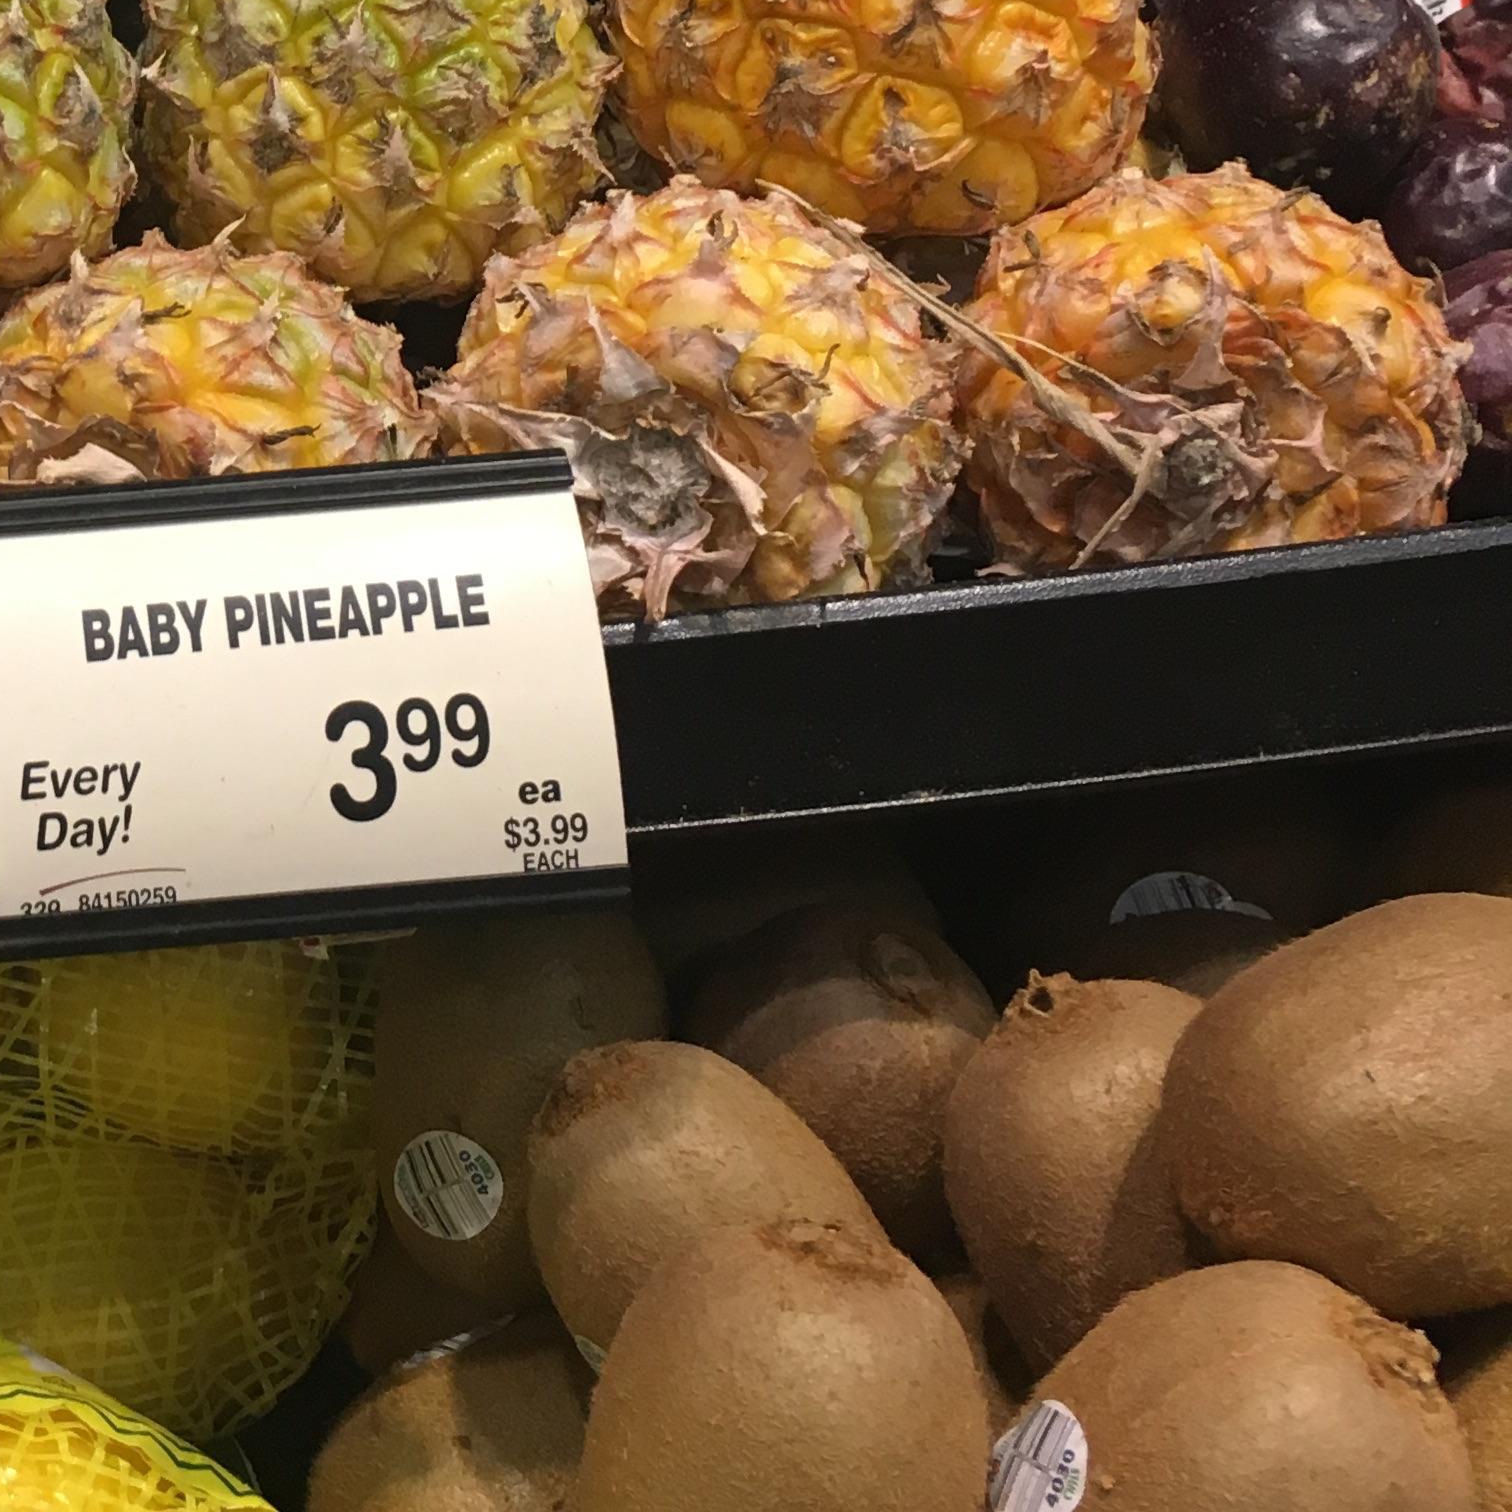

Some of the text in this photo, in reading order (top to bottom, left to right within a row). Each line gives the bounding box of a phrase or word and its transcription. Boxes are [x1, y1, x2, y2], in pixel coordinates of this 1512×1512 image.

[82, 574, 490, 662] BABY PINEAPPLE
[20, 759, 141, 802] Every
[518, 779, 562, 805] ea
[36, 805, 133, 855] Day!
[504, 812, 589, 853] $3.99
[523, 848, 580, 873] EACH
[78, 885, 178, 911] 84150259
[458, 1149, 489, 1195] 4030
[1045, 1448, 1076, 1508] 4030
